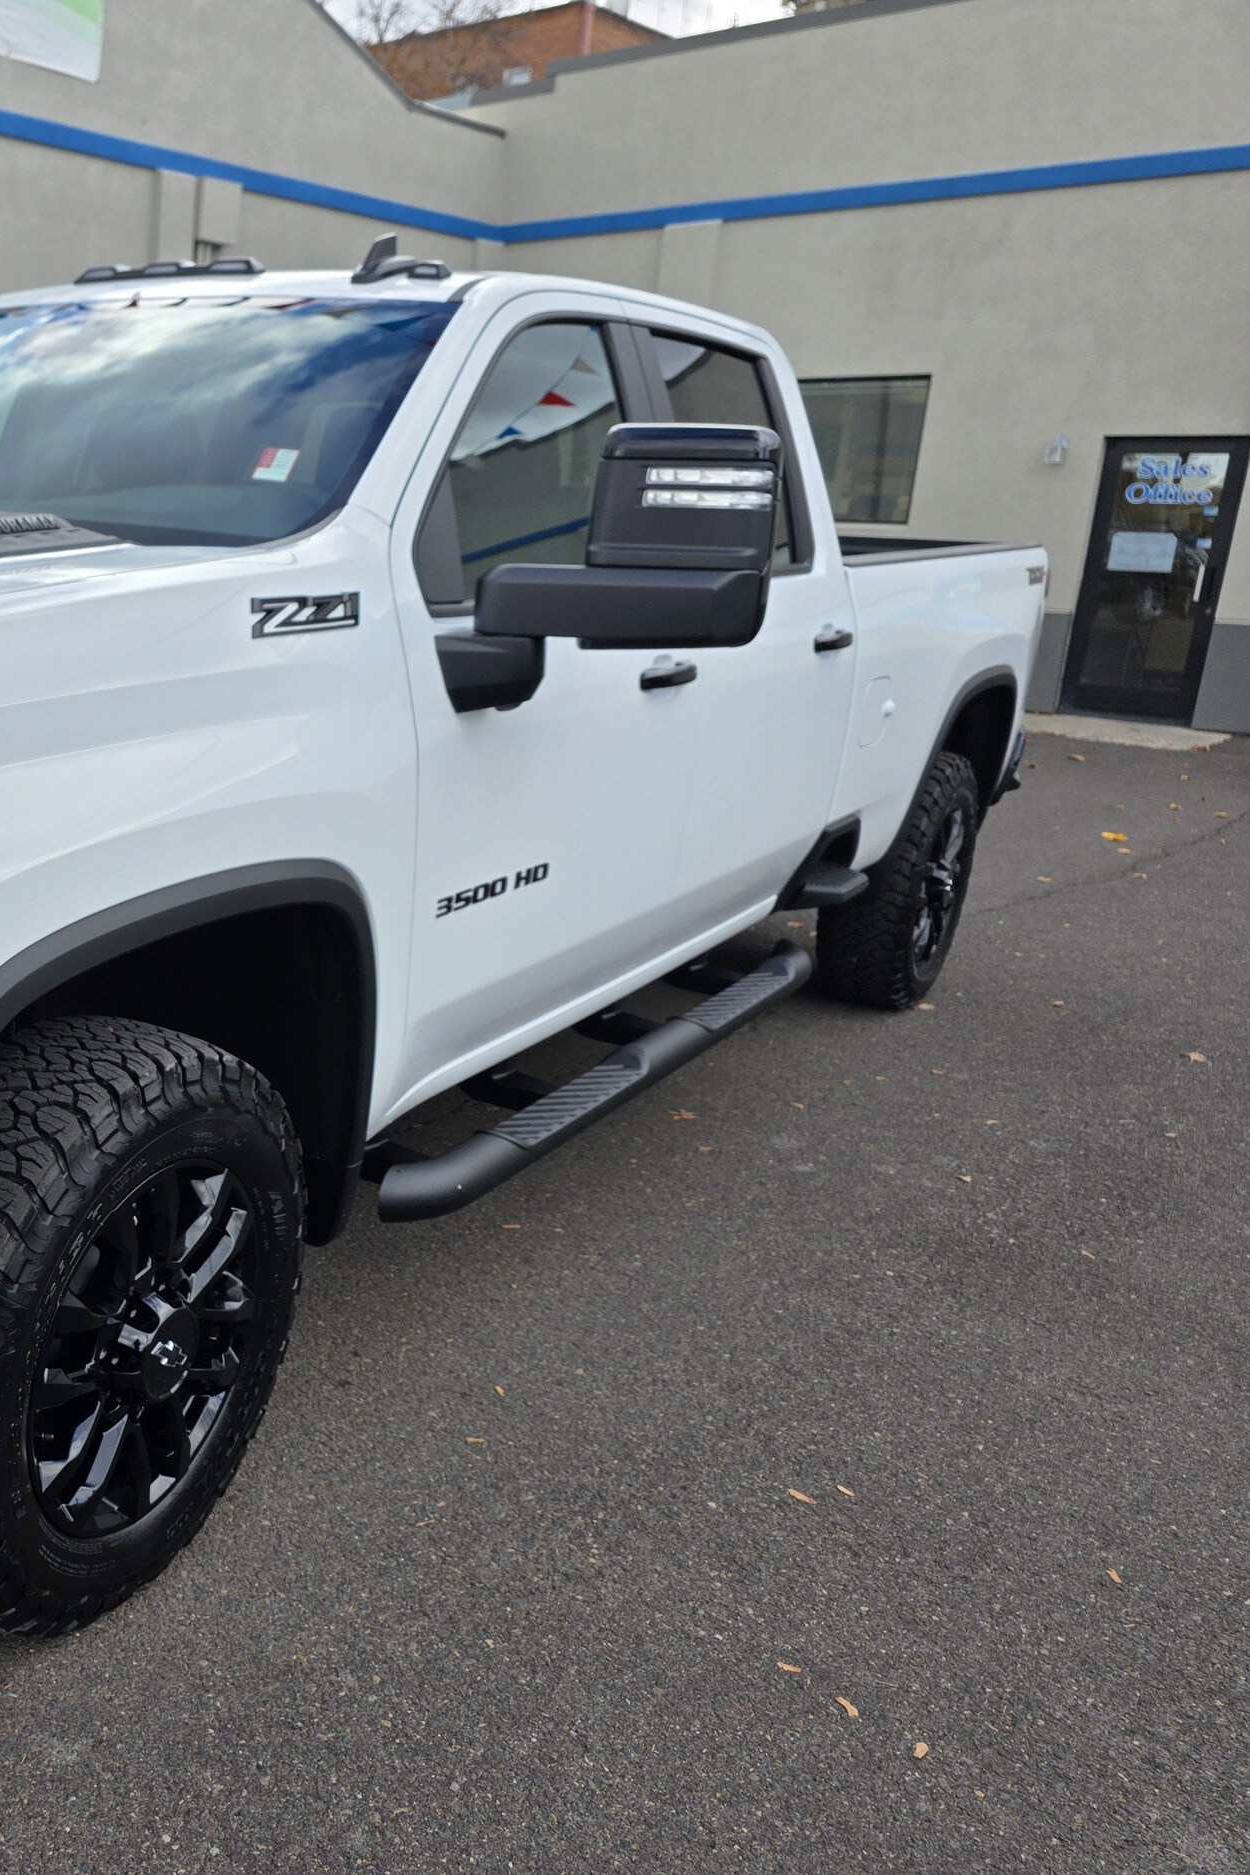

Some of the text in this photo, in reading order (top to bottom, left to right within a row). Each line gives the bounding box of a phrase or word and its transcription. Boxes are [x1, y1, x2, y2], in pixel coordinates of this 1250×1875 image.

[1137, 456, 1210, 479] Sales
[1125, 482, 1213, 505] Office
[251, 591, 360, 639] Z71
[435, 862, 550, 919] 3500 HD
